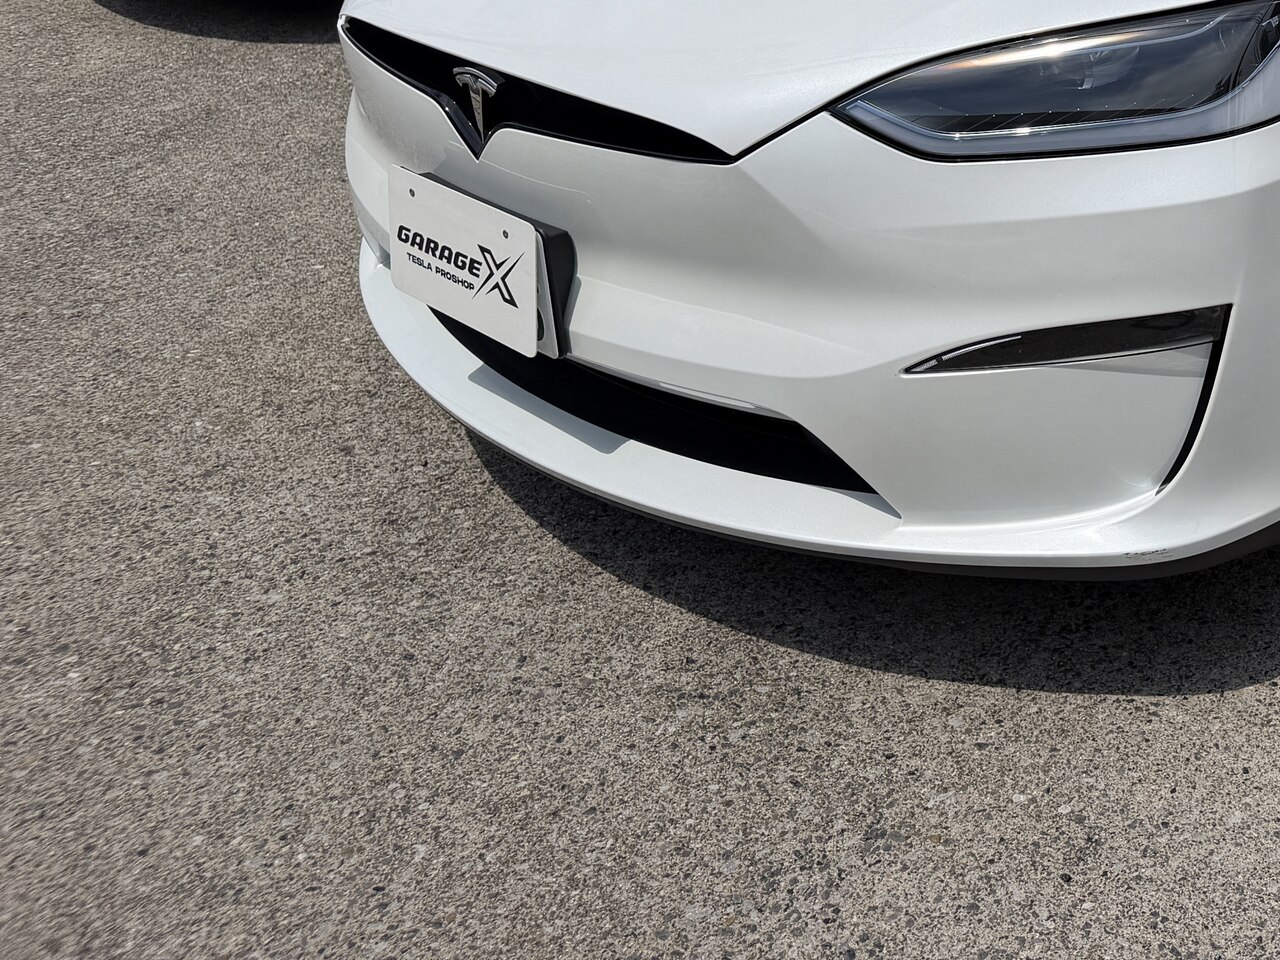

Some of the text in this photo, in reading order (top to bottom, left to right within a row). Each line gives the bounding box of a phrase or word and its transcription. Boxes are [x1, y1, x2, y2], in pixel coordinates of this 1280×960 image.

[397, 224, 483, 279] GARAGE
[406, 252, 475, 291] TESLA PROSHOP
